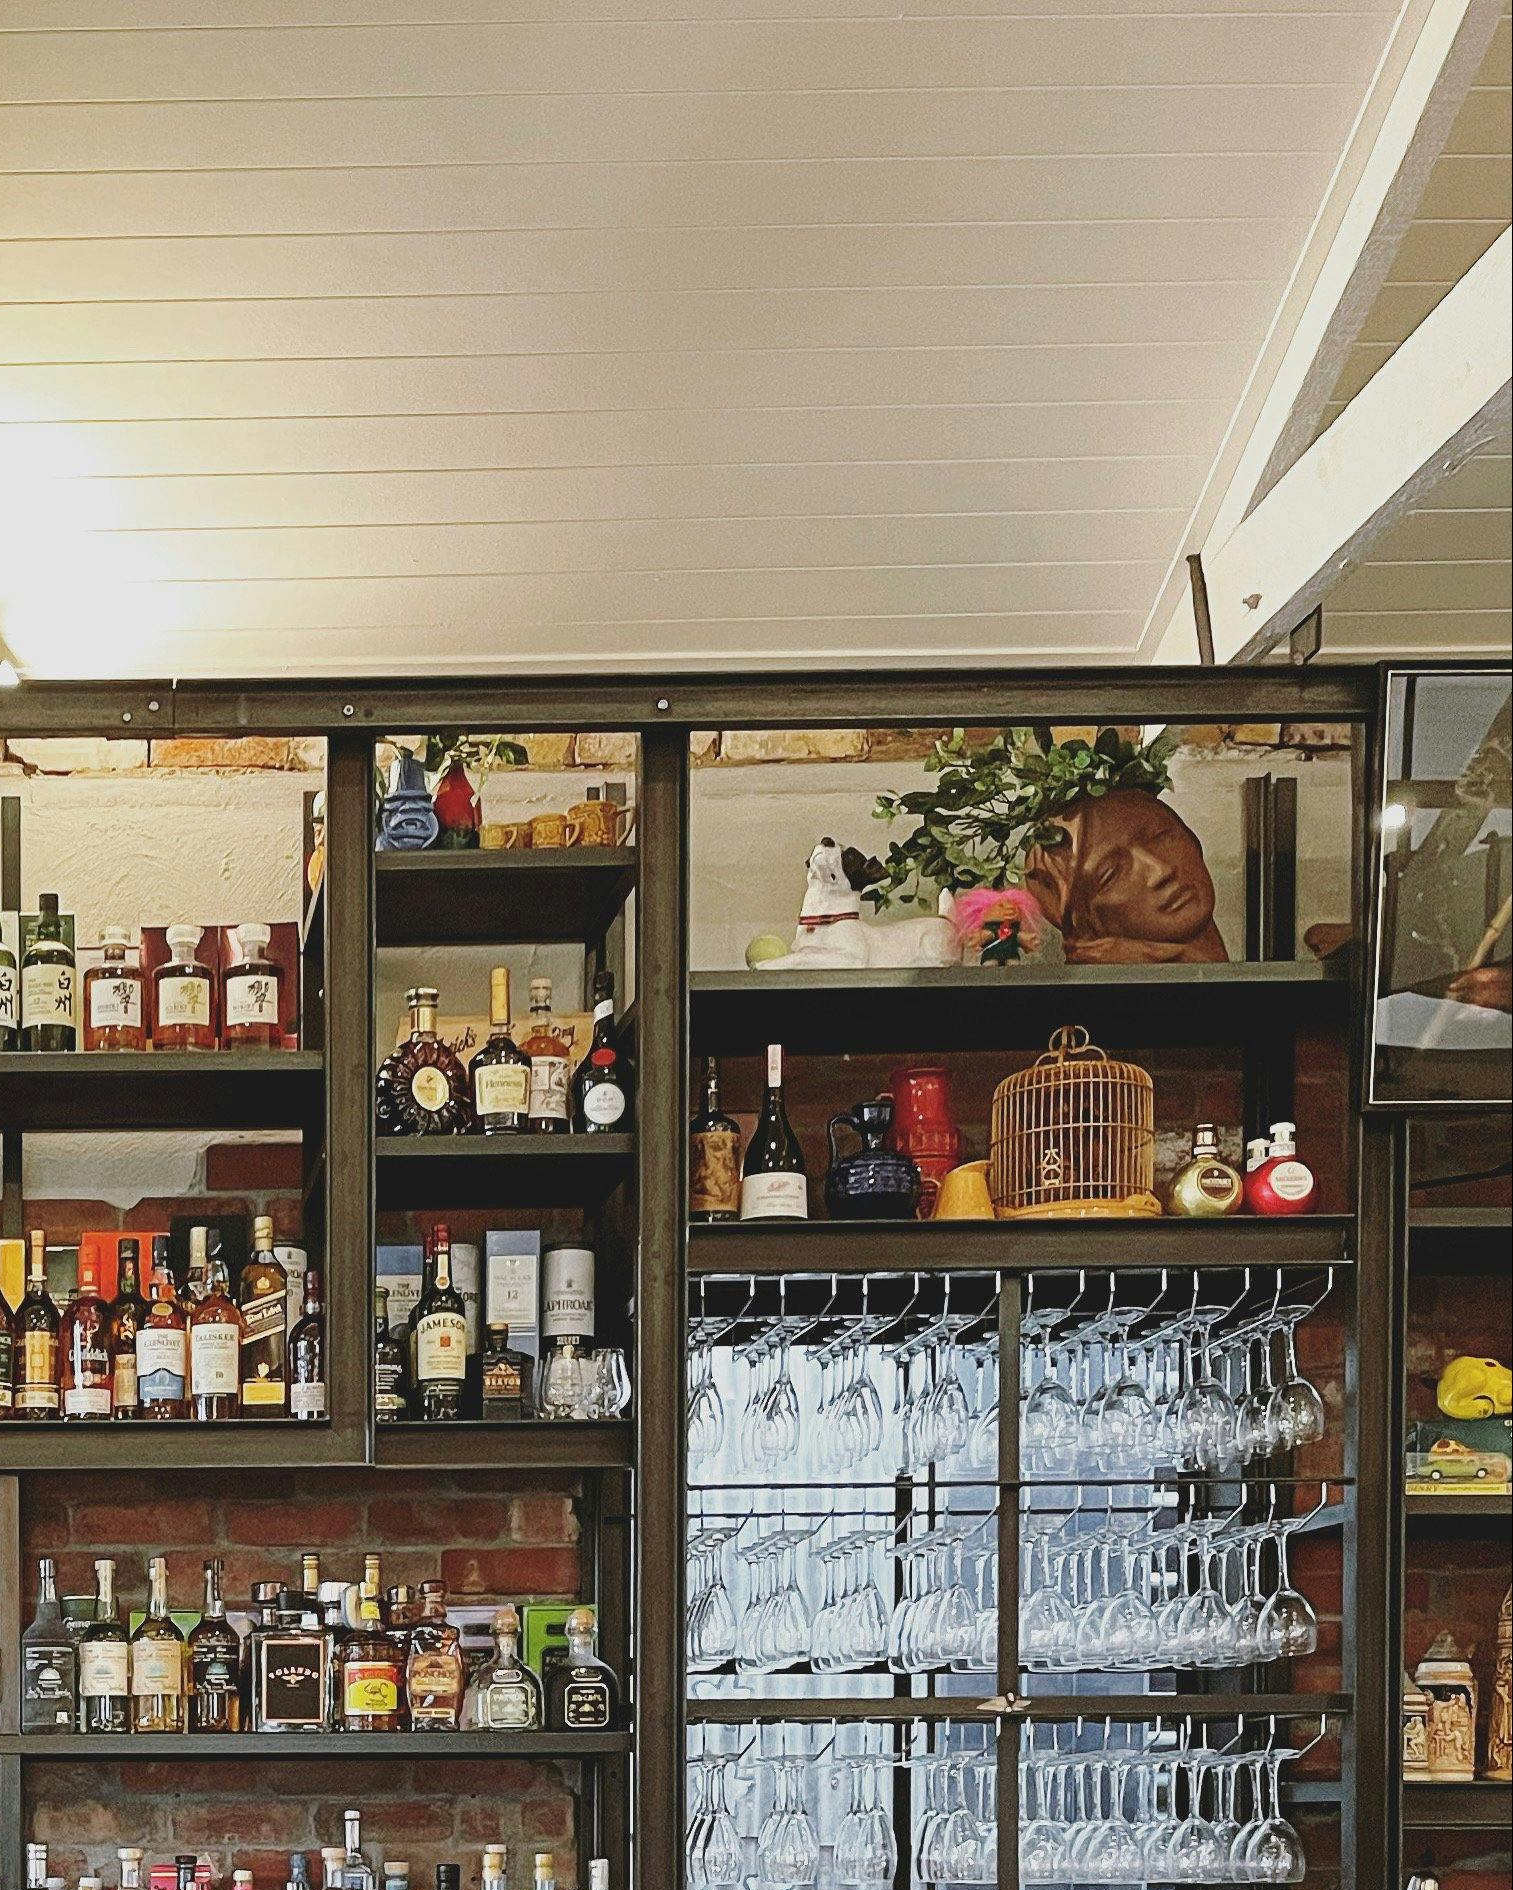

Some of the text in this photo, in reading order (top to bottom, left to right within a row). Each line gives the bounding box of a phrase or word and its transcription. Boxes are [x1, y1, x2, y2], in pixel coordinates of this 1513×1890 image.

[54, 970, 72, 1017] 白州
[112, 981, 137, 1015] 響
[248, 980, 273, 1013] 響
[506, 1291, 519, 1300] 12
[194, 1333, 237, 1342] TALISKER
[420, 1317, 467, 1335] JAMESON
